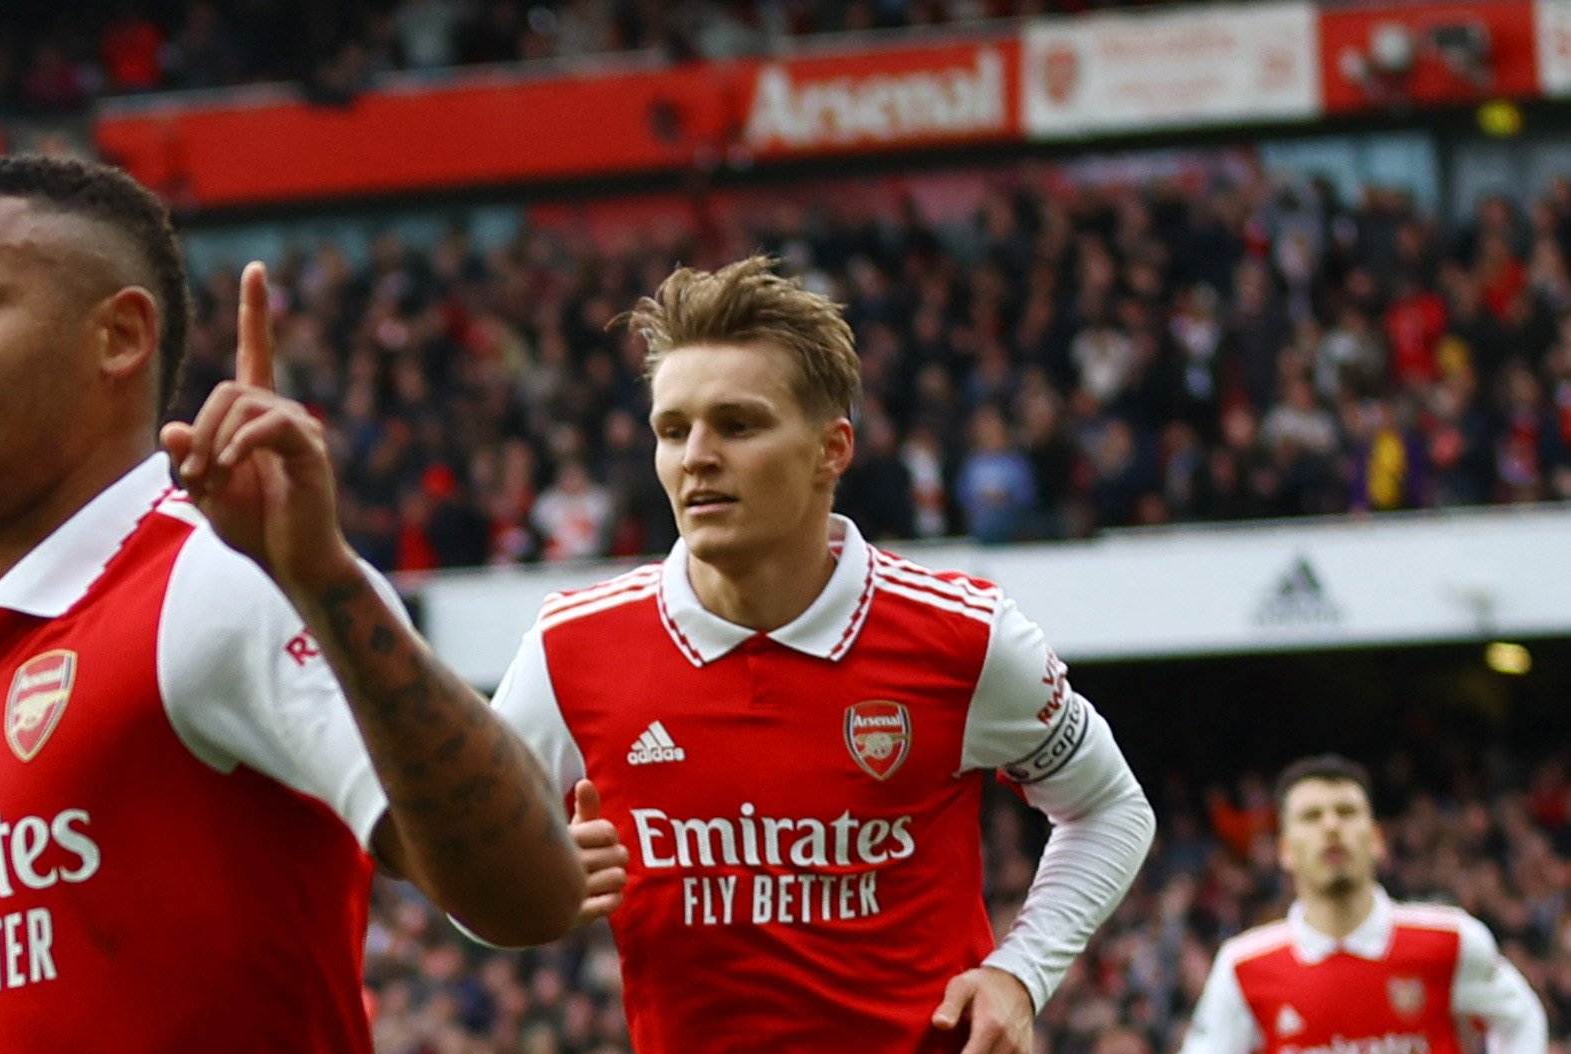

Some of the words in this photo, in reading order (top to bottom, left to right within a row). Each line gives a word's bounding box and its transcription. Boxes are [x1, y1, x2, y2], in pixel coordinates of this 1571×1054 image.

[748, 44, 1003, 150] Arsenal
[852, 713, 903, 727] Arsenal
[626, 747, 686, 765] adidas
[629, 802, 916, 868] Emirates
[683, 874, 737, 926] FLY
[752, 870, 880, 925] BETTER
